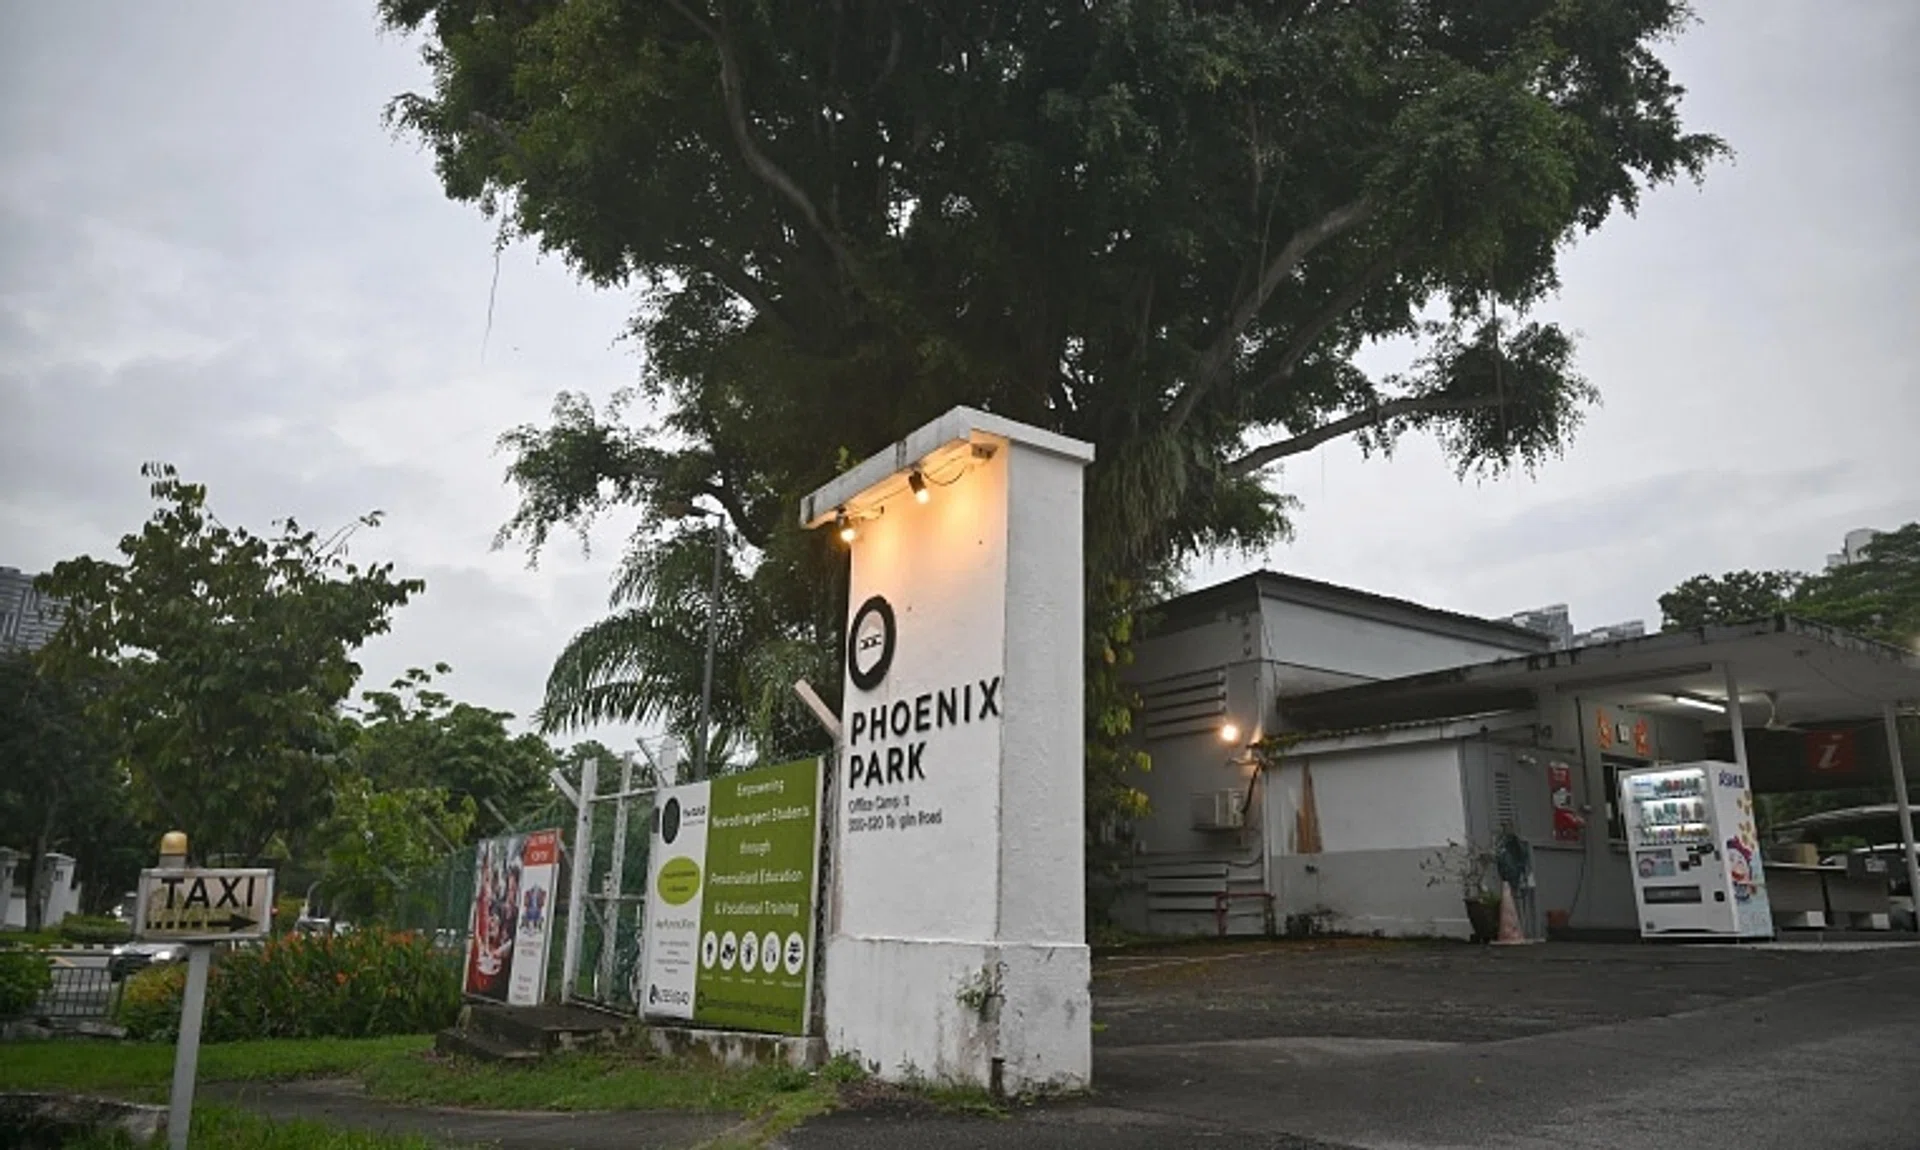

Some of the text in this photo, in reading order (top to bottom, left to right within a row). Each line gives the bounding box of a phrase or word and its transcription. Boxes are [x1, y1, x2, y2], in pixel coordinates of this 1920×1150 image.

[850, 676, 1000, 746] PHOENIX
[849, 741, 927, 790] PARK
[918, 808, 942, 826] Road
[161, 876, 255, 909] TAXI
